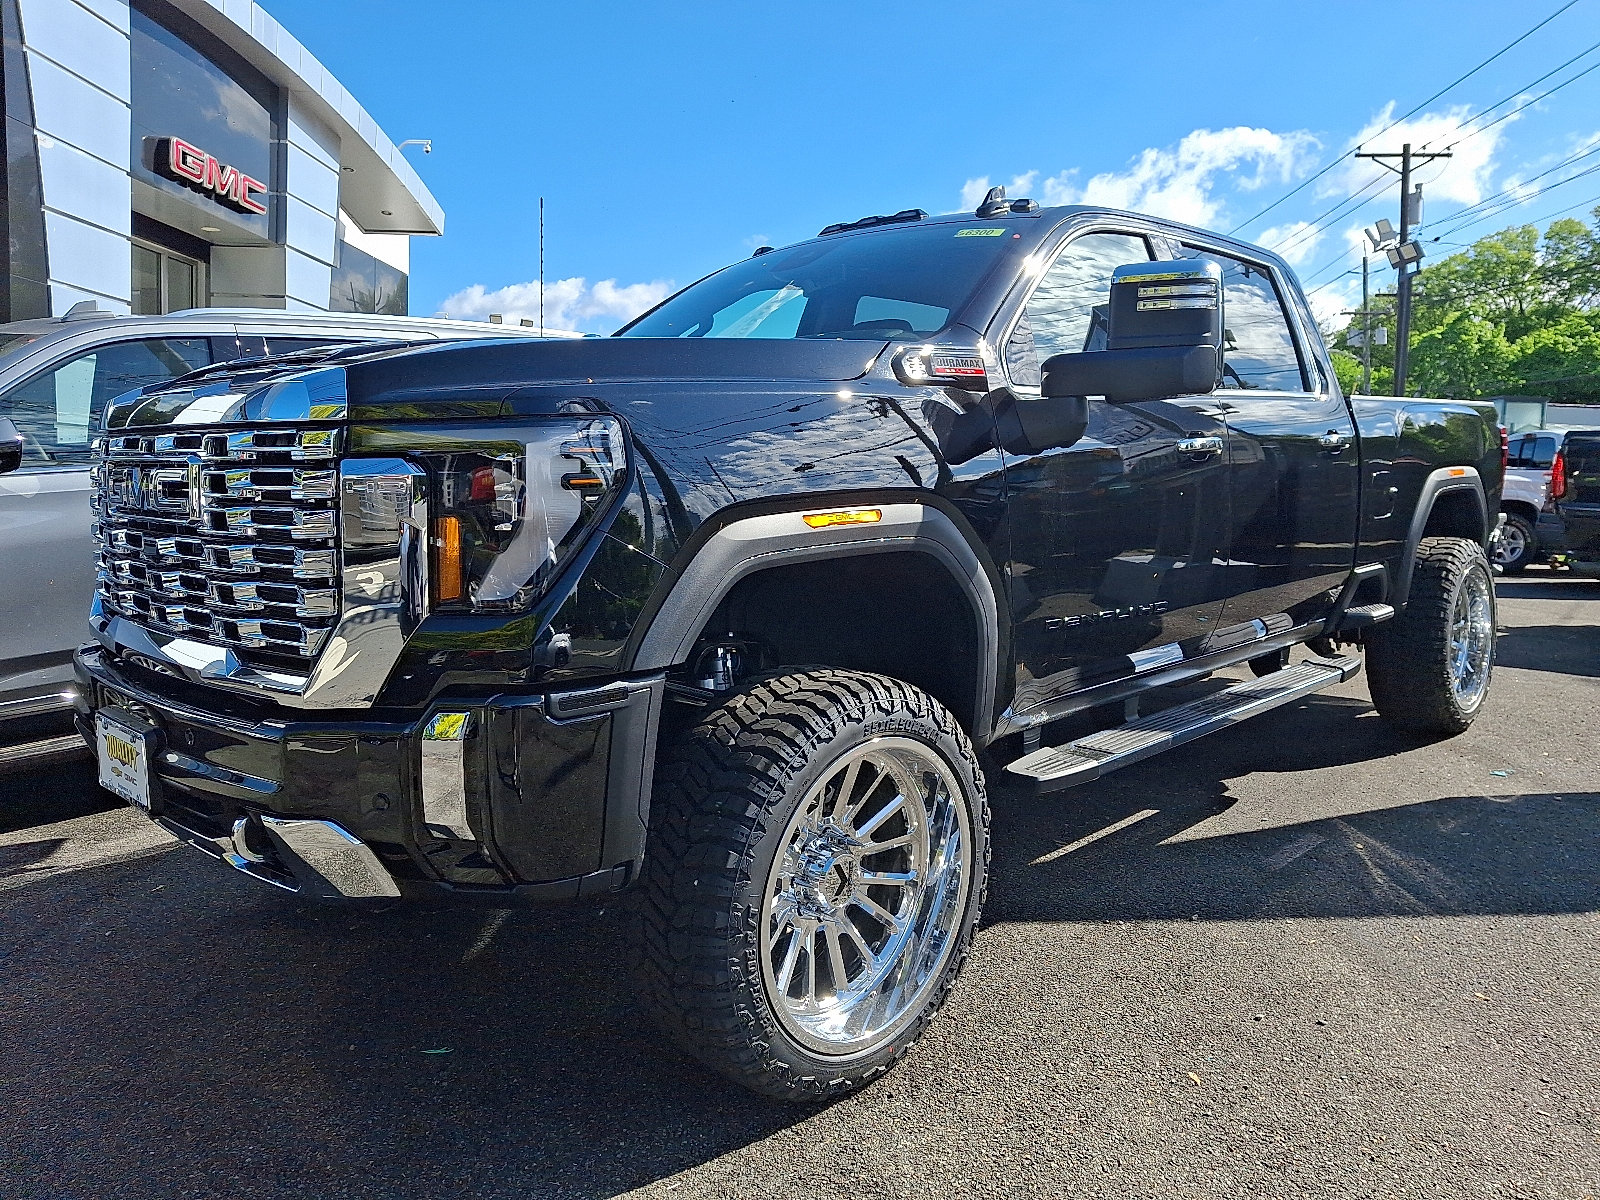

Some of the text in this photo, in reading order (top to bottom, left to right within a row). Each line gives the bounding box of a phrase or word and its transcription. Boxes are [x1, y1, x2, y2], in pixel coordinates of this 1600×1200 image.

[170, 136, 268, 216] GMC
[936, 357, 982, 368] DURAMAX
[108, 466, 189, 512] GMC
[1045, 604, 1135, 631] DENALI
